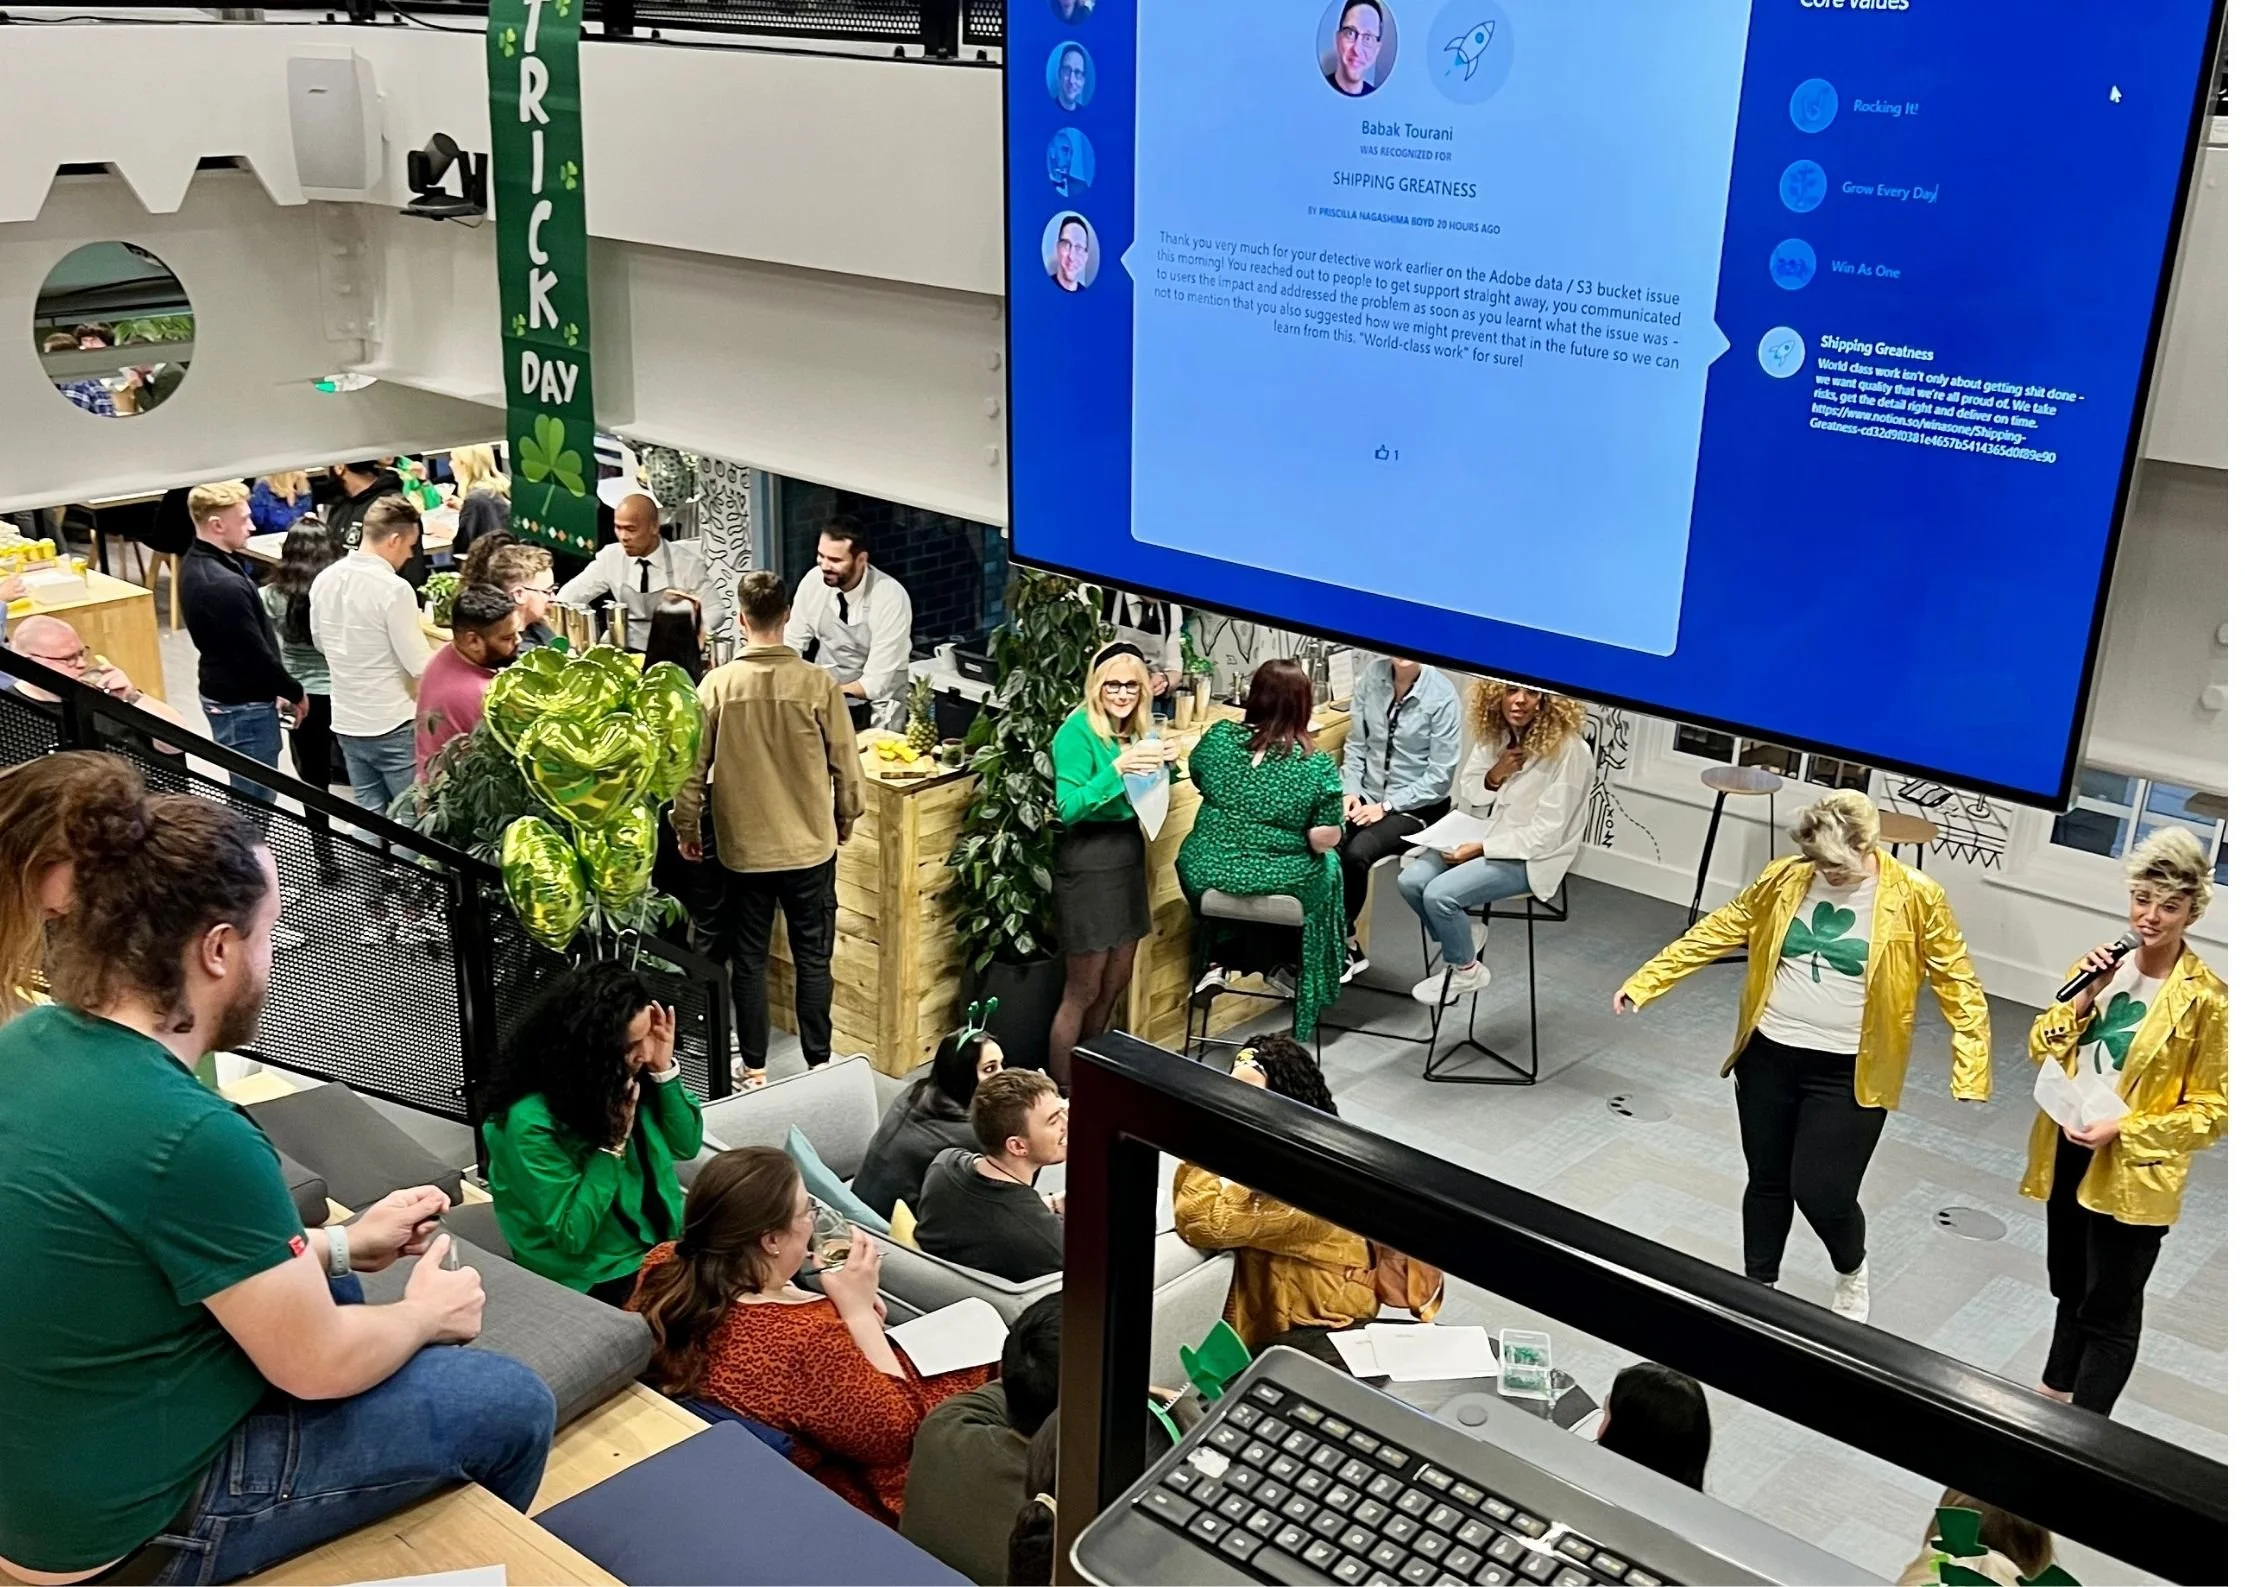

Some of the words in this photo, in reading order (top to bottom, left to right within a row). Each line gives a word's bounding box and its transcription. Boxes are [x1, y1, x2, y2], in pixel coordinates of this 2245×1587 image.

[1853, 99, 1902, 117] Rocking
[1362, 120, 1400, 137] Babak
[1405, 123, 1453, 141] Tourani
[1360, 145, 1378, 155] WAS
[1380, 146, 1433, 160] RECOGNIZED
[1435, 151, 1452, 161] FOR
[1333, 171, 1395, 190] SHIPPING
[1399, 177, 1477, 198] GREATNESS
[1842, 181, 1874, 195] Grow
[1877, 184, 1911, 201] Every
[1319, 207, 1357, 219] PRISCILLA
[1359, 211, 1409, 225] NAGASHIMA
[1411, 217, 1434, 228] BOYD
[1437, 219, 1447, 229] 20
[1449, 221, 1479, 232] HOURS
[1481, 224, 1501, 235] AGO
[1160, 231, 1190, 246] Thank
[1193, 239, 1212, 251] you
[1215, 242, 1237, 256] very
[1240, 242, 1269, 255] much
[1273, 243, 1288, 257] for
[1291, 250, 1317, 263] your
[1319, 249, 1371, 268] detective
[1374, 257, 1403, 272] work
[1406, 262, 1444, 277] earlier
[1446, 268, 1462, 279] on
[1466, 267, 1486, 282] the
[1489, 269, 1531, 287] Adobe
[1535, 274, 1563, 291] data
[1566, 279, 1574, 294] /
[1576, 280, 1592, 295] S3
[1597, 281, 1642, 301] bucket
[1646, 287, 1680, 305] issue
[1832, 260, 1855, 274] Win
[1857, 263, 1872, 276] As
[1875, 264, 1901, 279] One
[1157, 249, 1175, 262] this
[1228, 257, 1247, 271] You
[1250, 262, 1293, 277] reached
[1296, 269, 1315, 280] out
[1318, 269, 1330, 282] to
[1333, 273, 1372, 289] people
[1376, 276, 1388, 290] to
[1391, 280, 1410, 295] get
[1413, 283, 1460, 300] support
[1464, 288, 1510, 307] straight
[1514, 296, 1549, 314] away,
[1552, 300, 1577, 315] you
[1581, 304, 1681, 326] communicated
[1157, 268, 1167, 280] to
[1170, 272, 1196, 284] users
[1199, 273, 1215, 287] the
[1219, 276, 1254, 292] impact
[1257, 281, 1278, 295] and
[1280, 283, 1337, 302] addressed
[1340, 291, 1358, 306] the
[1361, 295, 1410, 312] problem
[1413, 304, 1426, 315] as
[1429, 305, 1459, 319] soon
[1462, 310, 1476, 321] as
[1478, 312, 1502, 326] you
[1505, 311, 1542, 330] learnt
[1545, 317, 1577, 335] what
[1581, 321, 1602, 338] the
[1606, 325, 1639, 342] issue
[1643, 333, 1668, 346] was
[1155, 288, 1171, 299] not
[1174, 289, 1184, 301] to
[1187, 293, 1230, 306] mention
[1233, 296, 1254, 311] that
[1257, 302, 1276, 315] you
[1280, 302, 1302, 317] also
[1305, 308, 1362, 326] suggested
[1366, 313, 1390, 329] how
[1393, 321, 1410, 332] we
[1413, 322, 1448, 340] might
[1451, 329, 1497, 344] prevent
[1501, 332, 1526, 348] that
[1530, 337, 1541, 351] in
[1546, 338, 1566, 354] the
[1570, 340, 1609, 360] future
[1613, 350, 1628, 362] so
[1632, 353, 1652, 365] we
[1655, 356, 1679, 369] can
[1274, 319, 1300, 335] learn
[1304, 323, 1330, 339] from
[1334, 328, 1356, 343] this.
[1359, 332, 1431, 354] "World-class
[1434, 344, 1469, 359] work"
[1473, 347, 1490, 363] for
[1820, 335, 1873, 356] Shipping
[1875, 342, 1934, 361] Greatness
[522, 351, 579, 405] DAY
[1818, 358, 1848, 372] World
[1849, 362, 1873, 375] class
[1875, 368, 1901, 379] work
[1925, 373, 1950, 387] only
[1950, 376, 1982, 390] about
[1983, 382, 2023, 397] getting
[2024, 385, 2046, 398] shit
[2046, 388, 2077, 402] done
[1815, 375, 1831, 385] we
[1832, 378, 1857, 388] want
[1858, 381, 1893, 396] quality
[1895, 384, 1915, 396] that
[1946, 392, 1960, 402] all
[1960, 395, 1994, 407] proud
[2012, 399, 2031, 412] We
[2032, 403, 2057, 416] take
[1840, 393, 1857, 404] get
[1859, 394, 1876, 406] the
[1877, 397, 1907, 410] detail
[1907, 401, 1933, 415] right
[1934, 406, 1955, 417] and
[1956, 407, 1992, 422] deliver
[1993, 414, 2009, 424] on
[1394, 449, 1399, 461] 1
